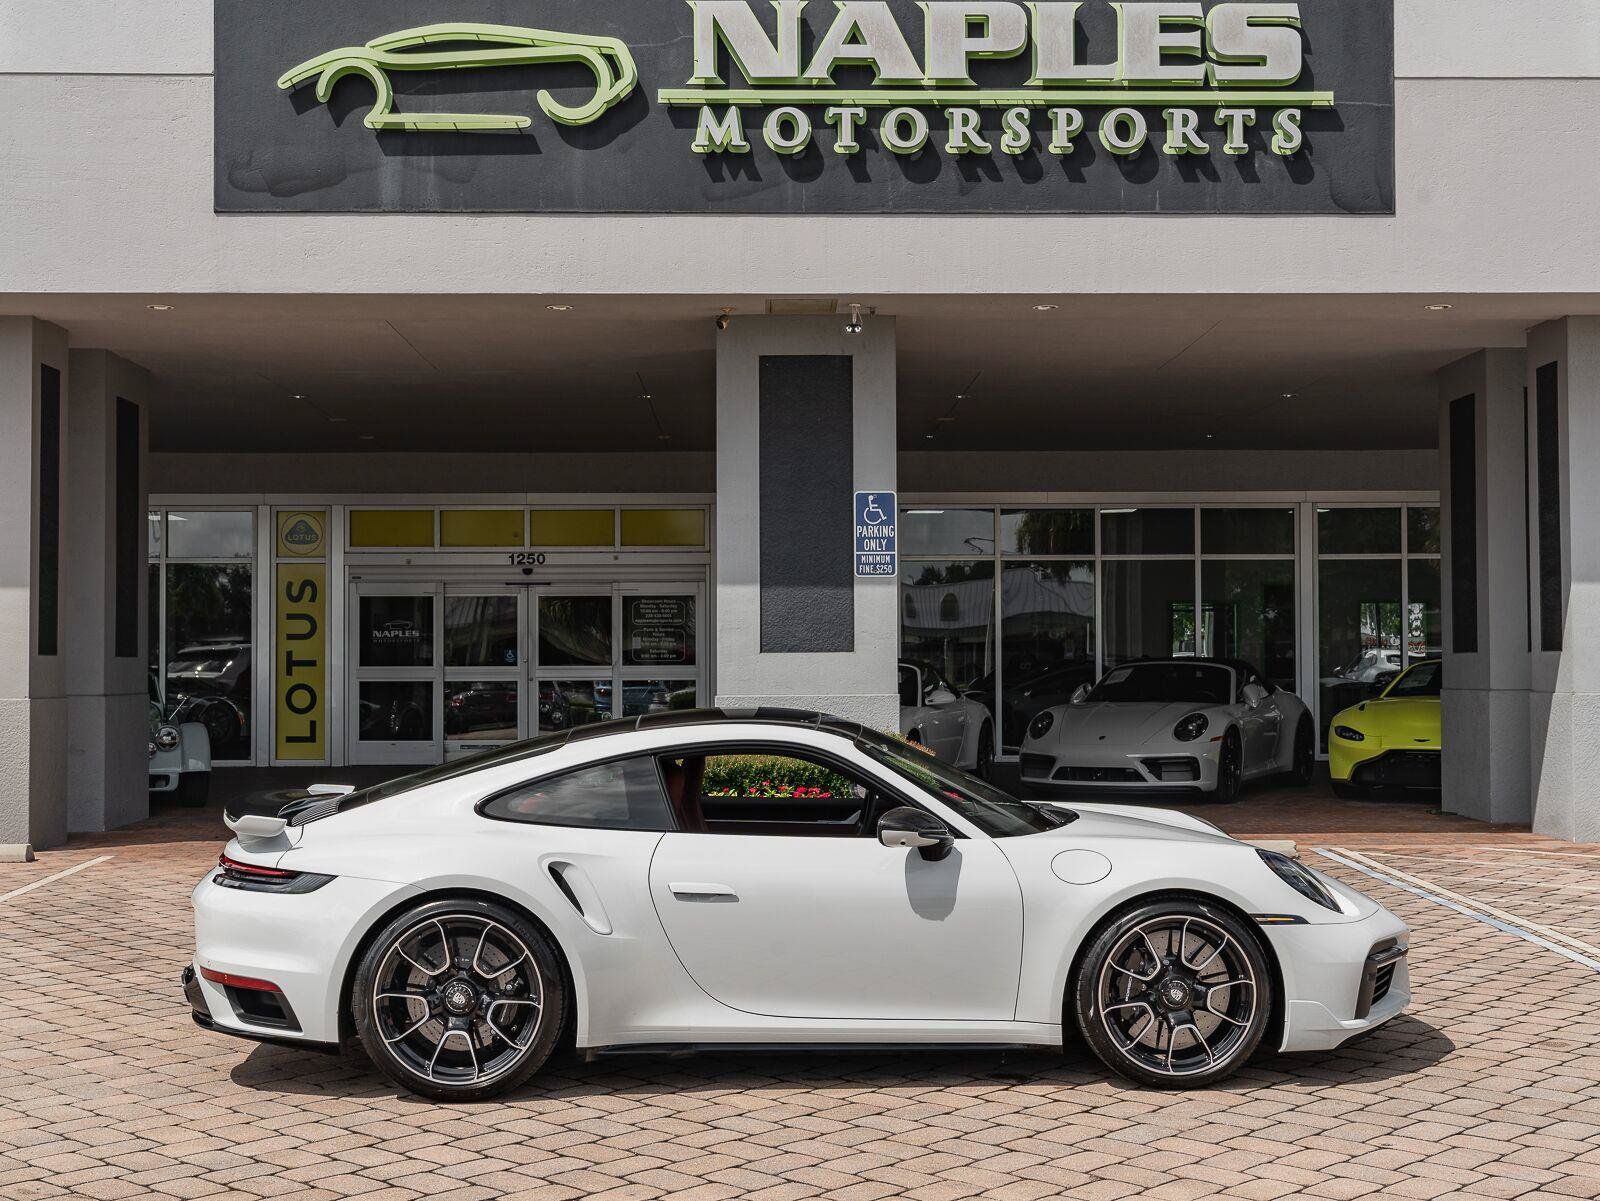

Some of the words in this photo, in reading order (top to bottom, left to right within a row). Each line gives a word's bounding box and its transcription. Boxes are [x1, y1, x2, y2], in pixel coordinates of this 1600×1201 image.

[686, 0, 1302, 86] NAPLES
[690, 106, 1303, 154] MOTORSPORTS
[287, 534, 317, 542] LOTUS
[856, 525, 895, 538] PARKING
[863, 538, 888, 551] ONLY
[508, 552, 546, 566] 1250
[861, 554, 891, 564] MINIMUM
[859, 564, 874, 574] FINE
[876, 564, 893, 574] $250
[372, 630, 420, 638] NAPLES
[285, 578, 318, 744] LOTUS
